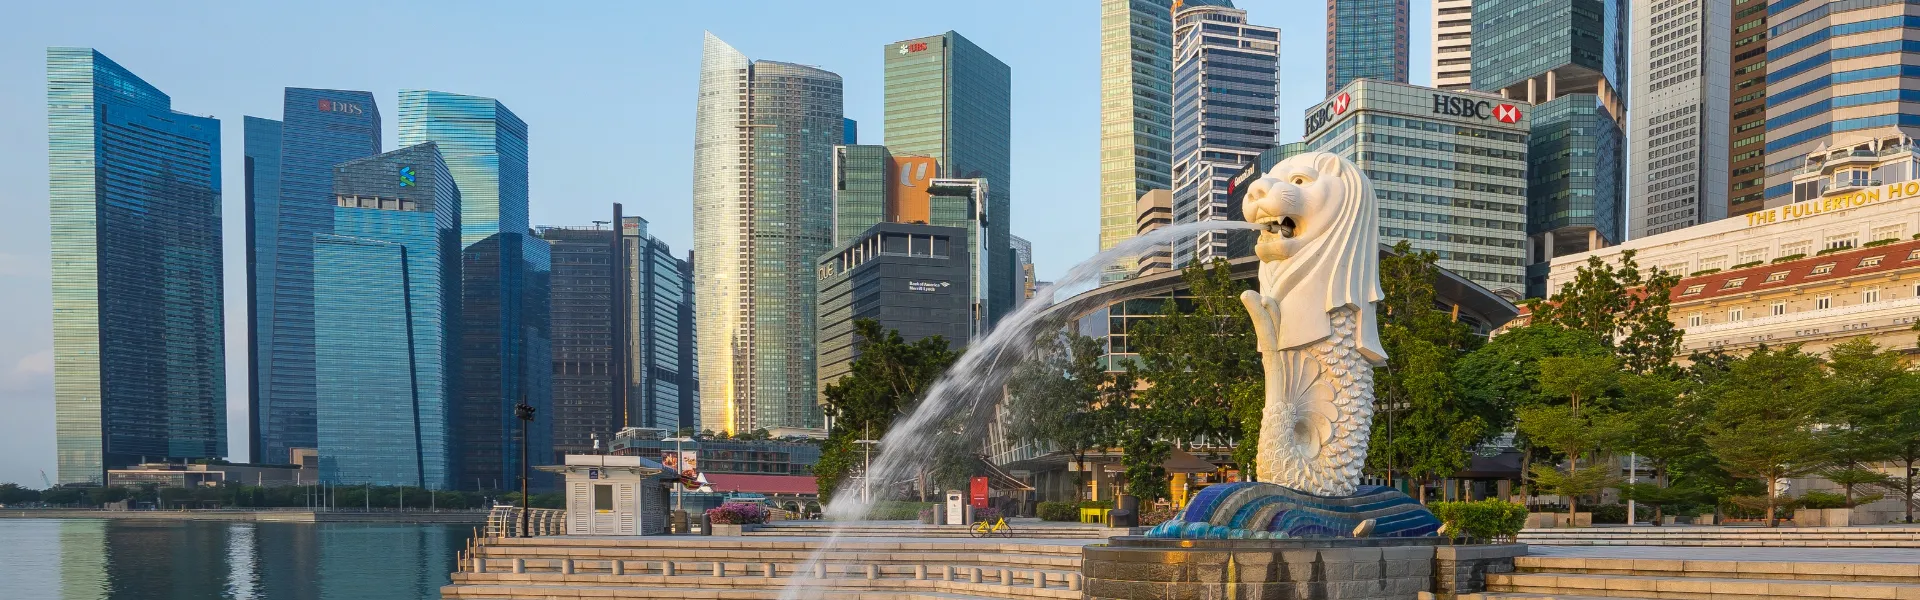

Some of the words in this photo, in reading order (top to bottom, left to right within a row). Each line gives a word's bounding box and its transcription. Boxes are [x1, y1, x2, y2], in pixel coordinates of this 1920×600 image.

[909, 42, 928, 52] UBS
[332, 101, 363, 115] DBS
[1305, 101, 1334, 137] HSBC
[1433, 94, 1490, 120] HSBC
[1746, 210, 1776, 227] THE
[1782, 188, 1880, 220] FULLERTON
[1888, 181, 1920, 199] HO
